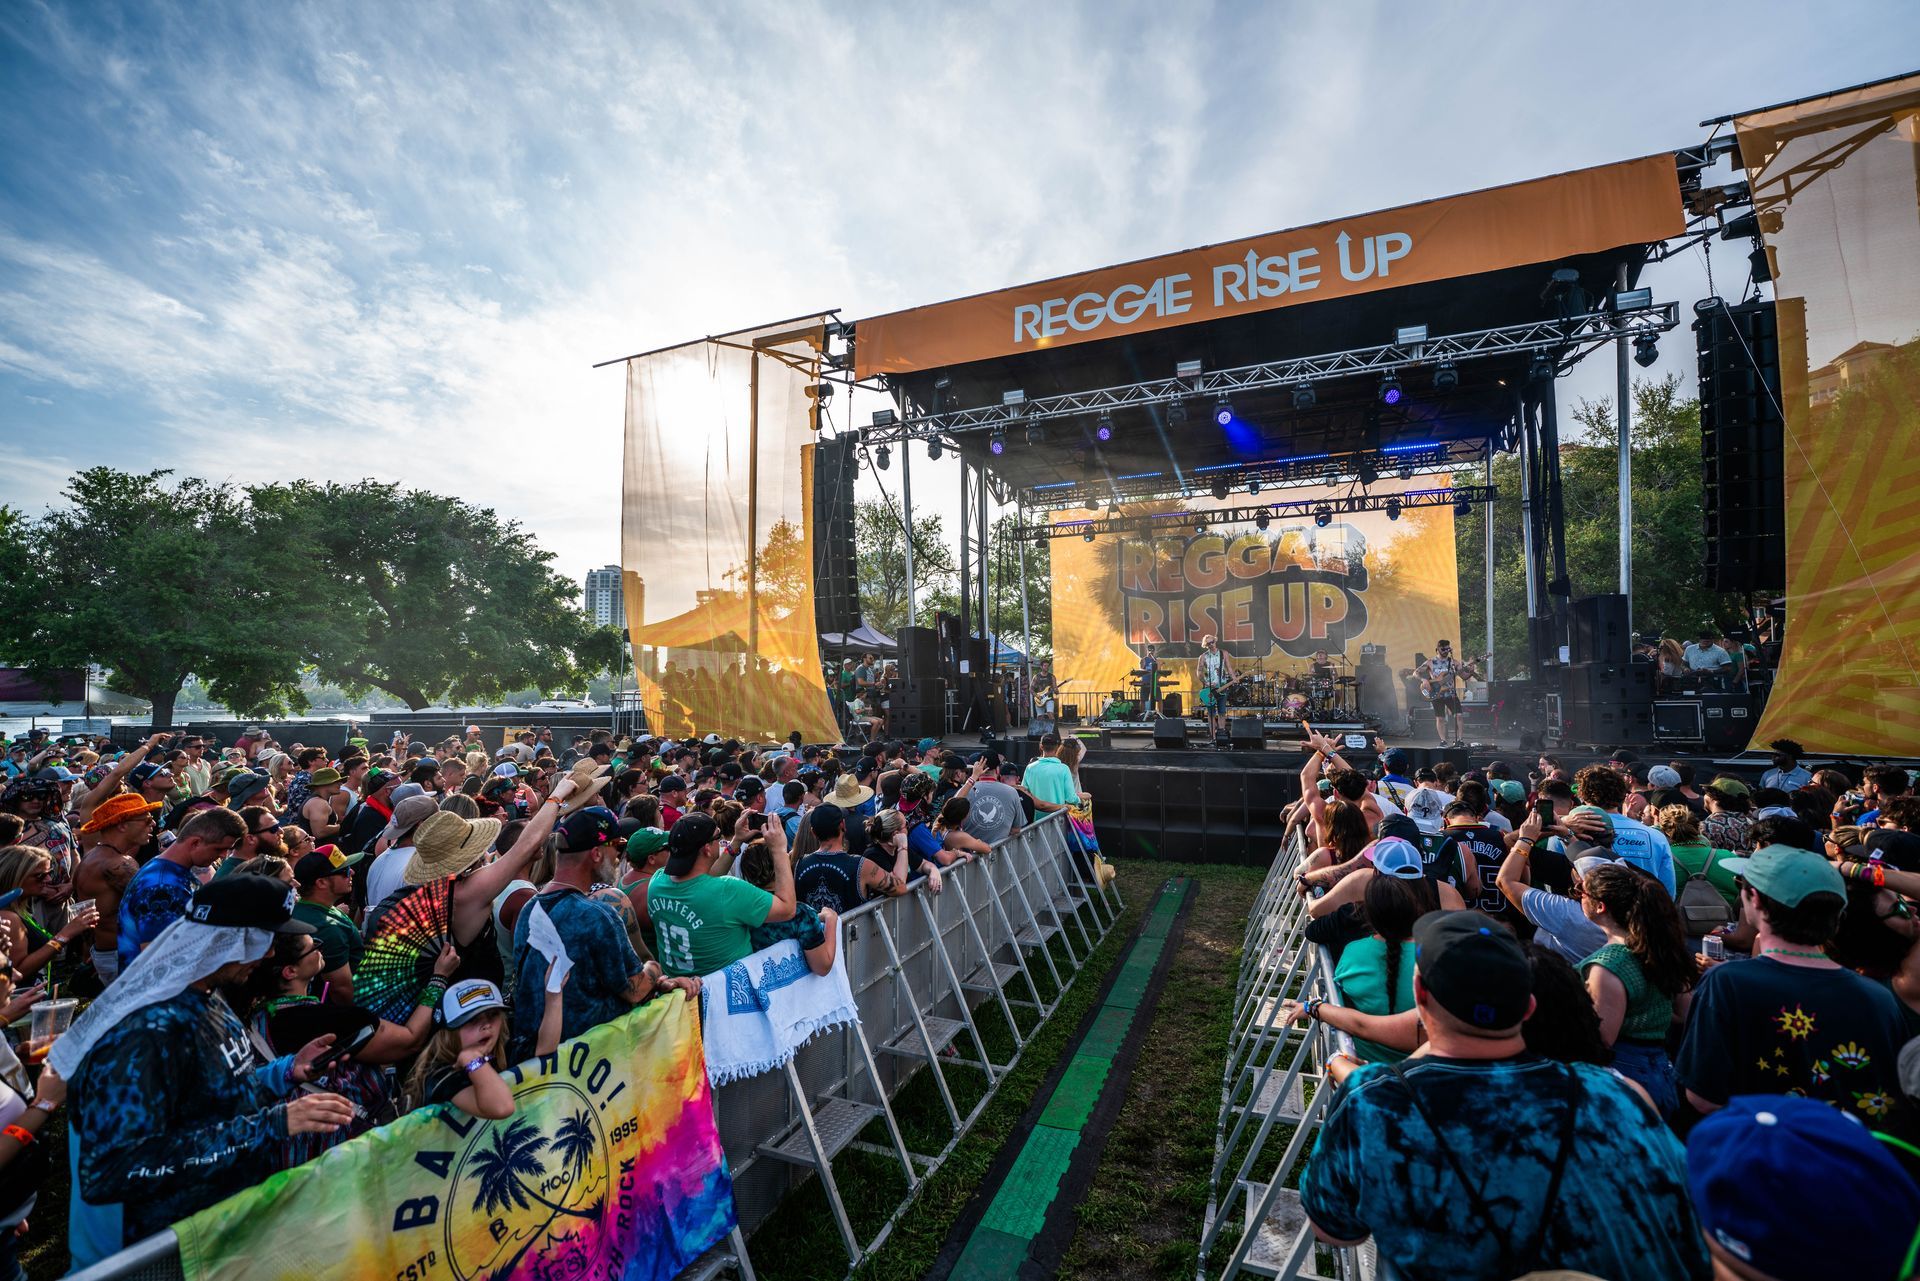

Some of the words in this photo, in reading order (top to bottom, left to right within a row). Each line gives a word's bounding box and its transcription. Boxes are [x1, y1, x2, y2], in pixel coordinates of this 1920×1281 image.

[1014, 273, 1192, 343] REGGAE
[1213, 249, 1320, 306] RISE
[1335, 230, 1412, 282] UP
[1122, 525, 1350, 593] REGGAE
[1129, 590, 1255, 645] RISE
[1268, 582, 1349, 642] UP
[1617, 837, 1646, 847] Crew
[649, 898, 704, 930] LOVATERS
[659, 920, 695, 972] 13
[609, 1116, 638, 1146] 1995
[617, 1156, 636, 1231] ROCK
